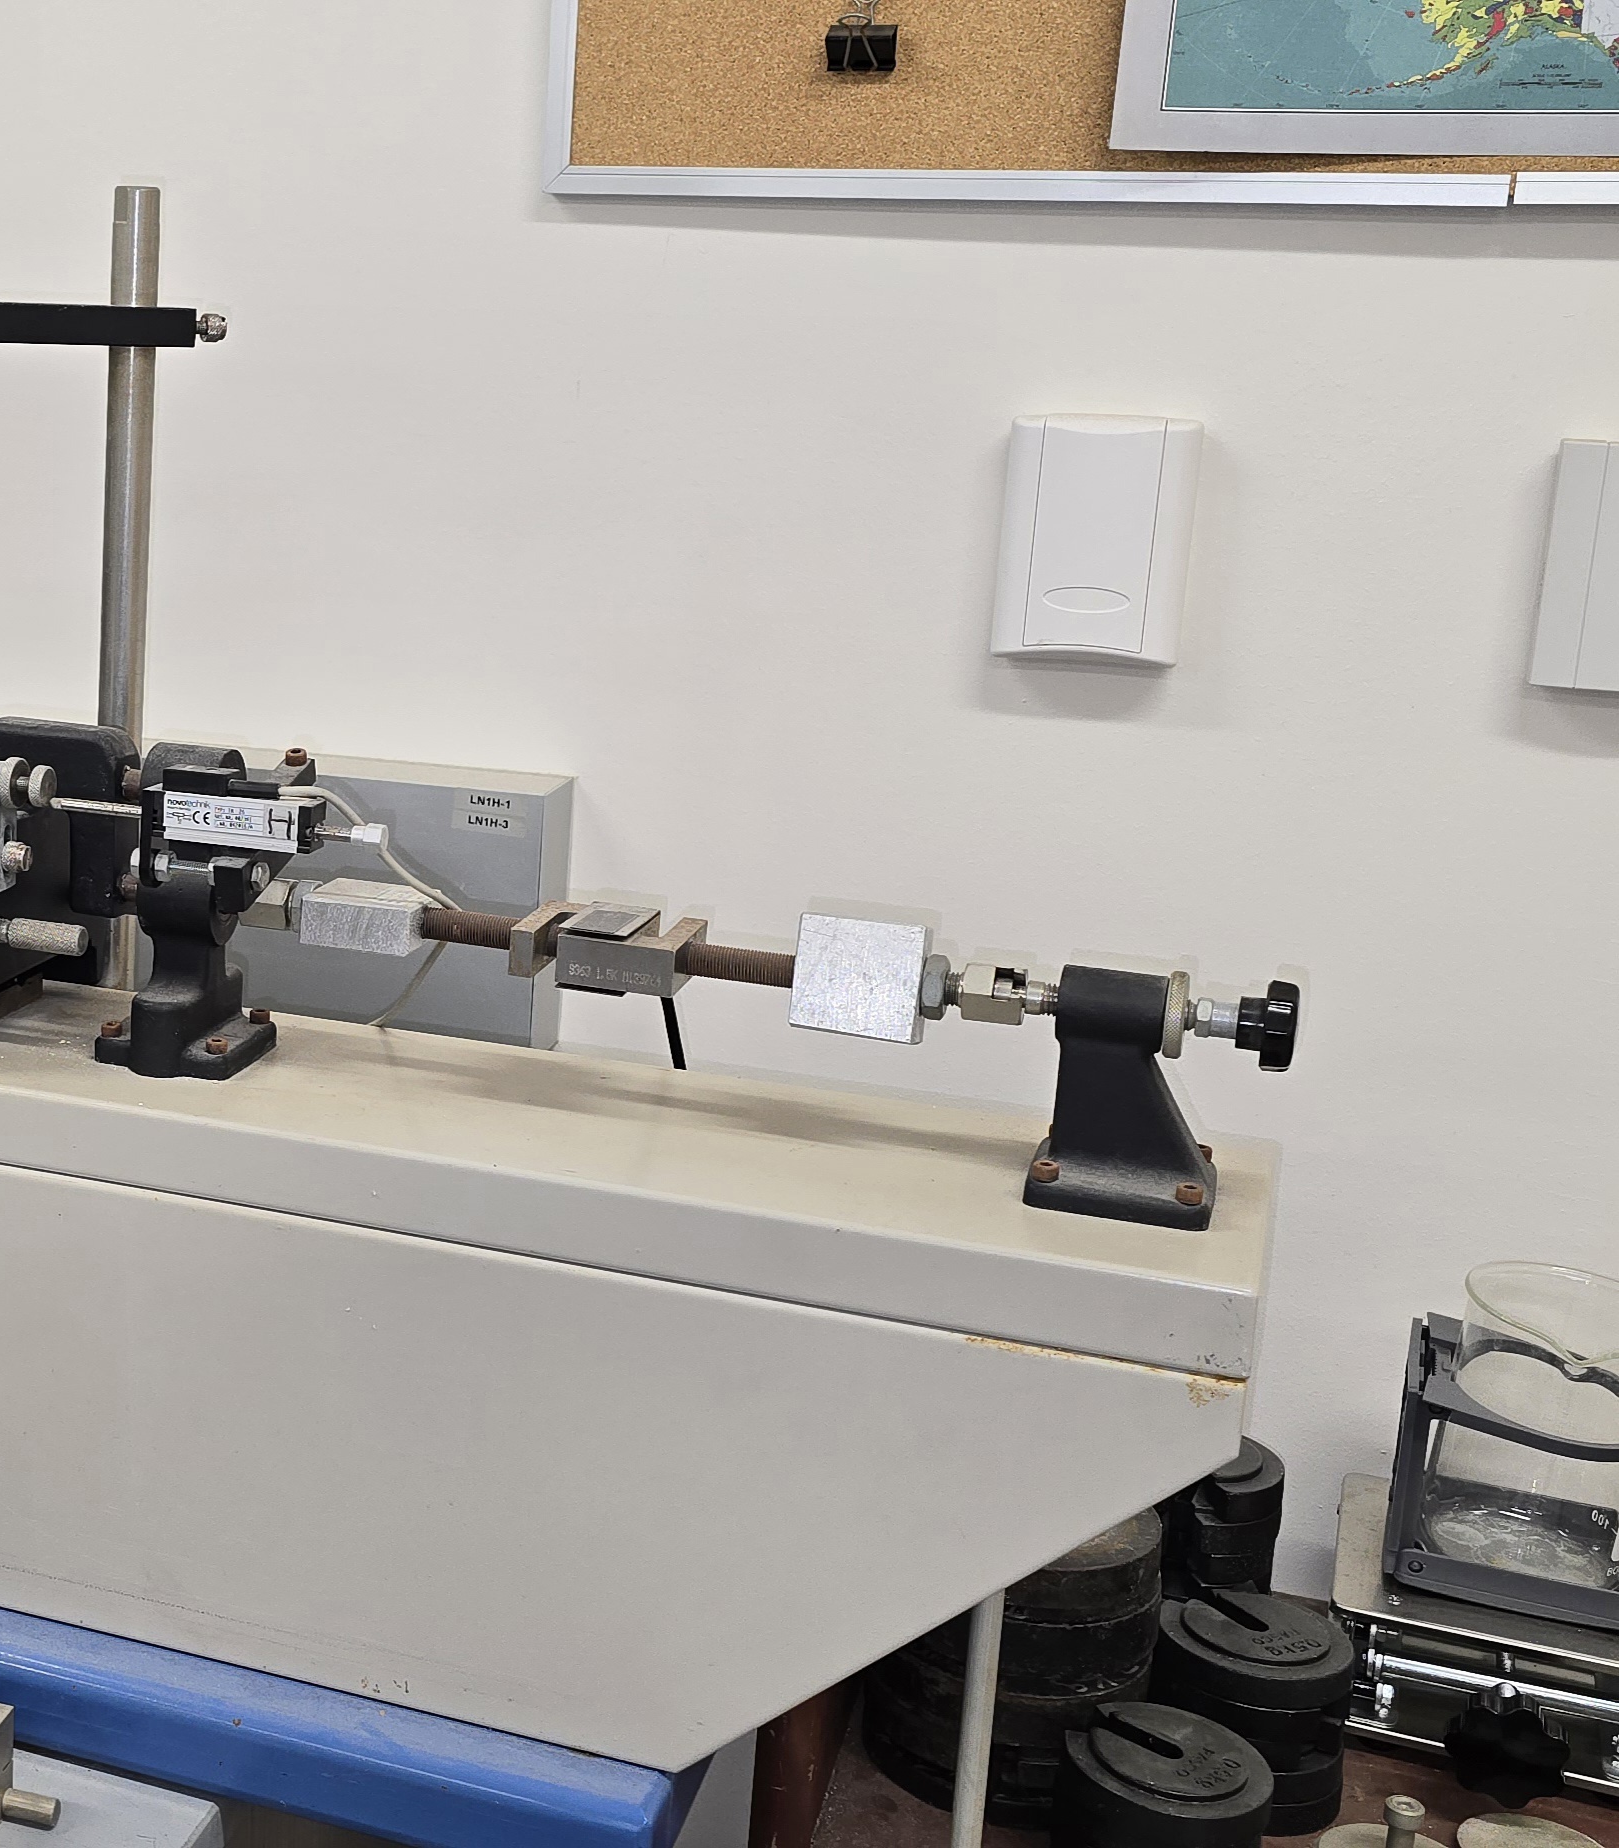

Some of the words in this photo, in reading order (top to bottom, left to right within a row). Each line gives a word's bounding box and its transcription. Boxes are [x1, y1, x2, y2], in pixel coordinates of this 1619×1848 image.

[167, 798, 211, 808] novotechnik
[469, 794, 511, 809] LN1H-1
[268, 808, 293, 840] H
[467, 815, 509, 829] LN1H-3
